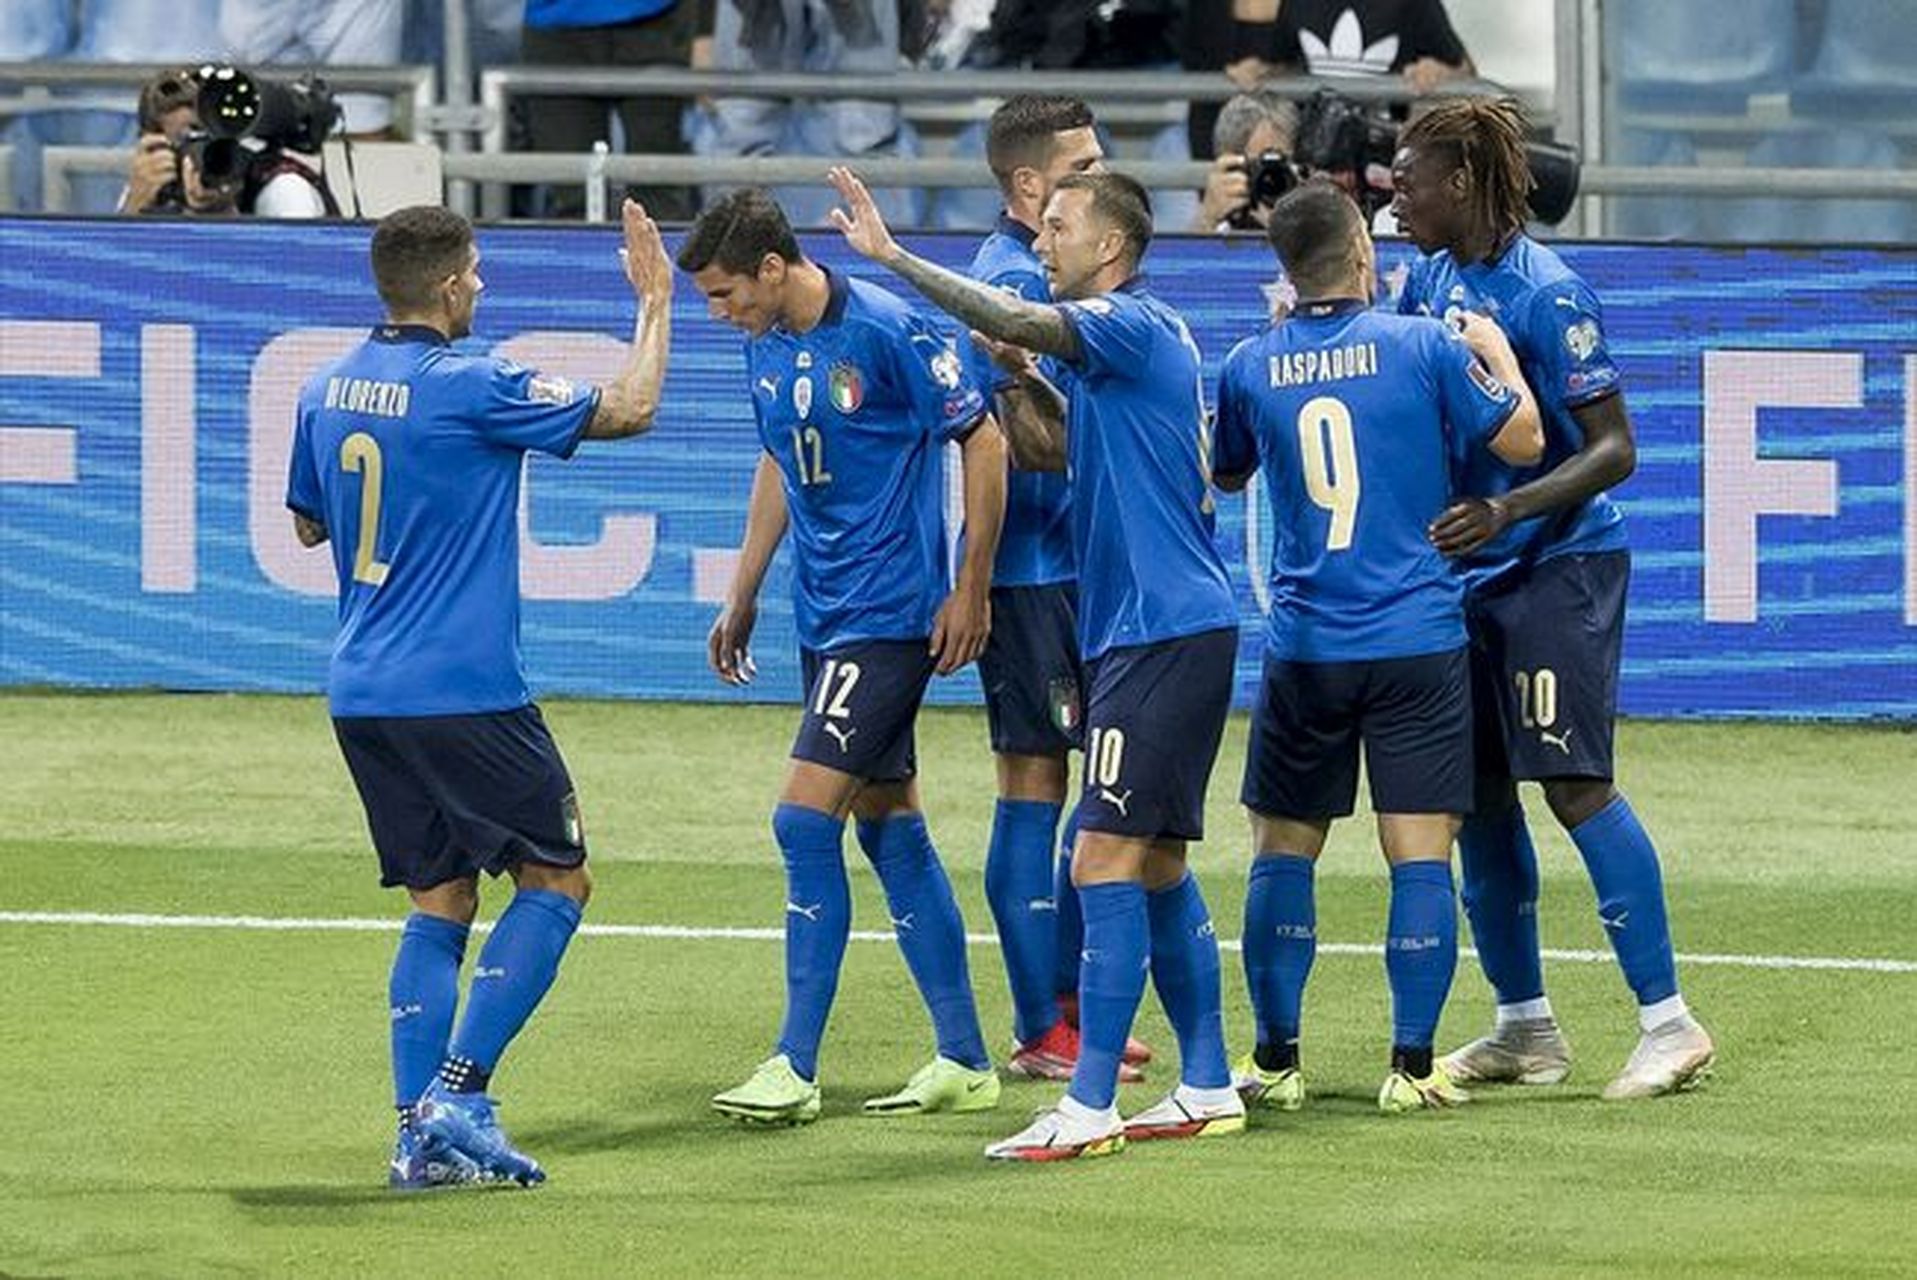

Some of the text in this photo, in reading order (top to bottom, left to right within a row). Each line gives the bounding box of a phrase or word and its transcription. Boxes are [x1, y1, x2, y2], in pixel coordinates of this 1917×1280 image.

[1268, 342, 1378, 388] RASPADORI
[792, 427, 832, 485] 12
[1297, 397, 1360, 550] 9
[340, 432, 391, 584] 2
[1704, 351, 1917, 627] F
[815, 660, 860, 717] 12
[1515, 669, 1556, 728] 20
[1088, 728, 1124, 786] 10
